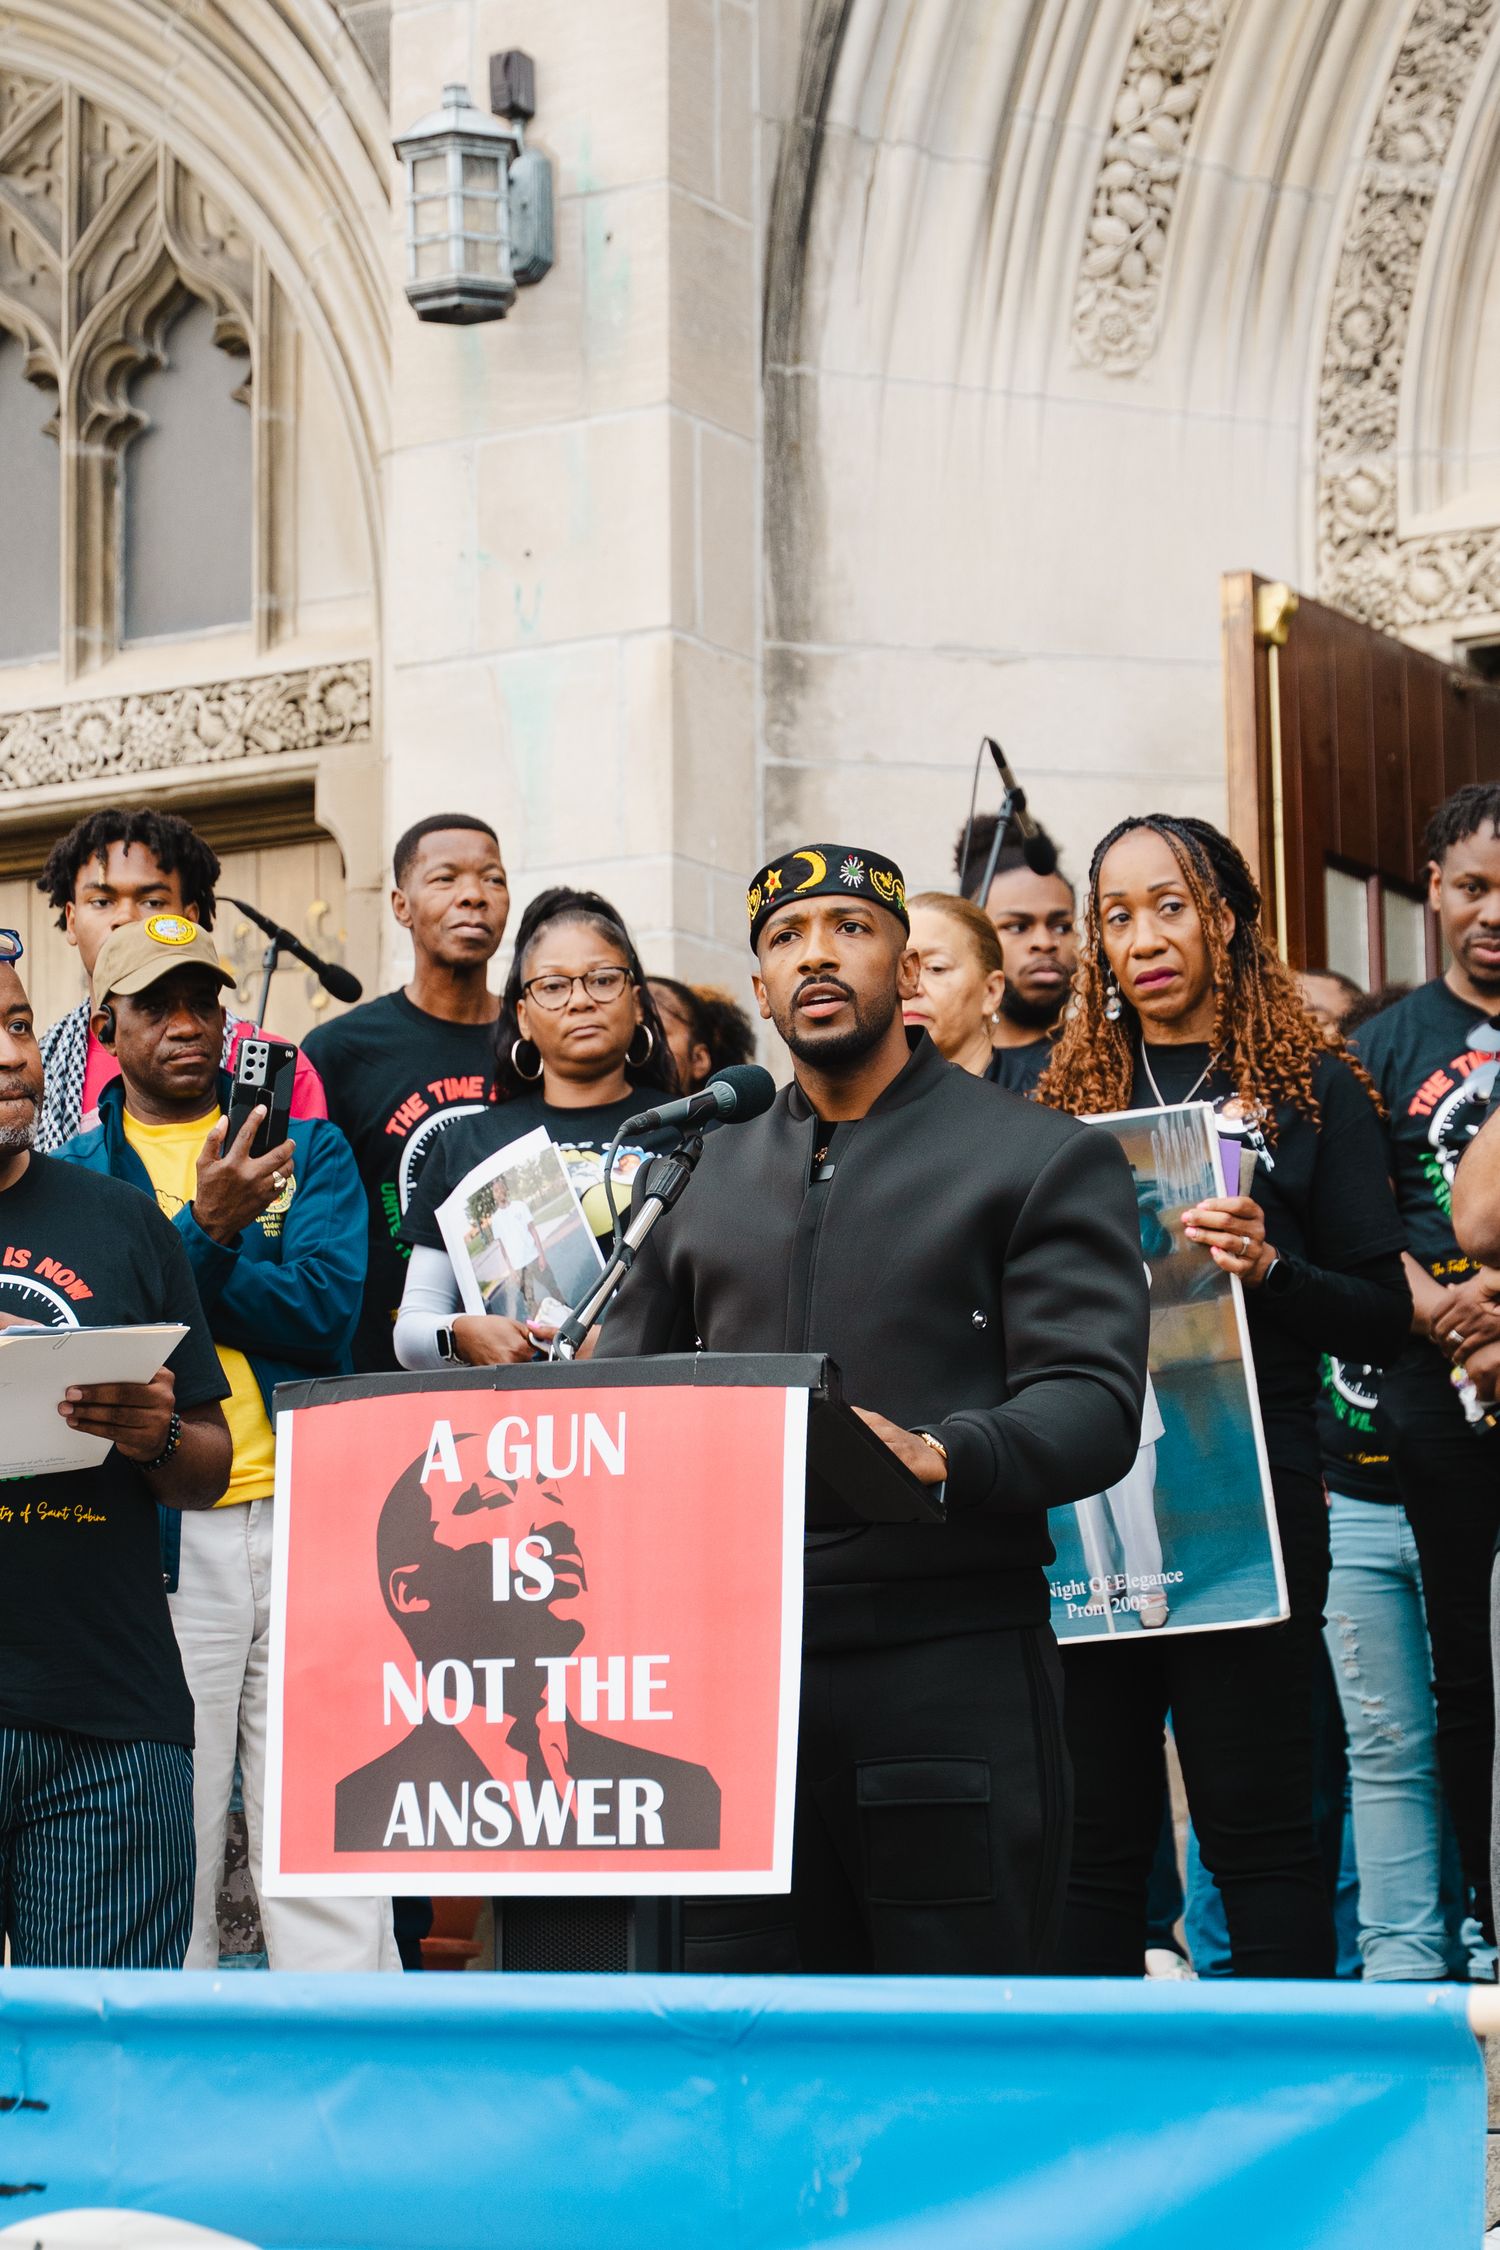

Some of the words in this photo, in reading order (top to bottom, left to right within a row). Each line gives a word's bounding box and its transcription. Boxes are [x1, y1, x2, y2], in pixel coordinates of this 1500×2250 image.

[385, 1091, 429, 1137] THE
[427, 1075, 485, 1104] TIME
[1408, 1068, 1455, 1117] THE
[3, 1246, 32, 1268] IS
[34, 1256, 94, 1301] NOW
[420, 1419, 463, 1484] A
[486, 1411, 627, 1481] GUN
[20, 1503, 31, 1524] of
[37, 1501, 71, 1520] Saint
[74, 1504, 107, 1523] Sabina
[491, 1535, 556, 1602] IS
[1089, 1575, 1112, 1593] Of
[1114, 1570, 1185, 1592] Elegance
[1066, 1602, 1107, 1619] Prom
[382, 1658, 515, 1726] NOT
[535, 1654, 673, 1723] THE
[382, 1777, 665, 1847] ANSWER
